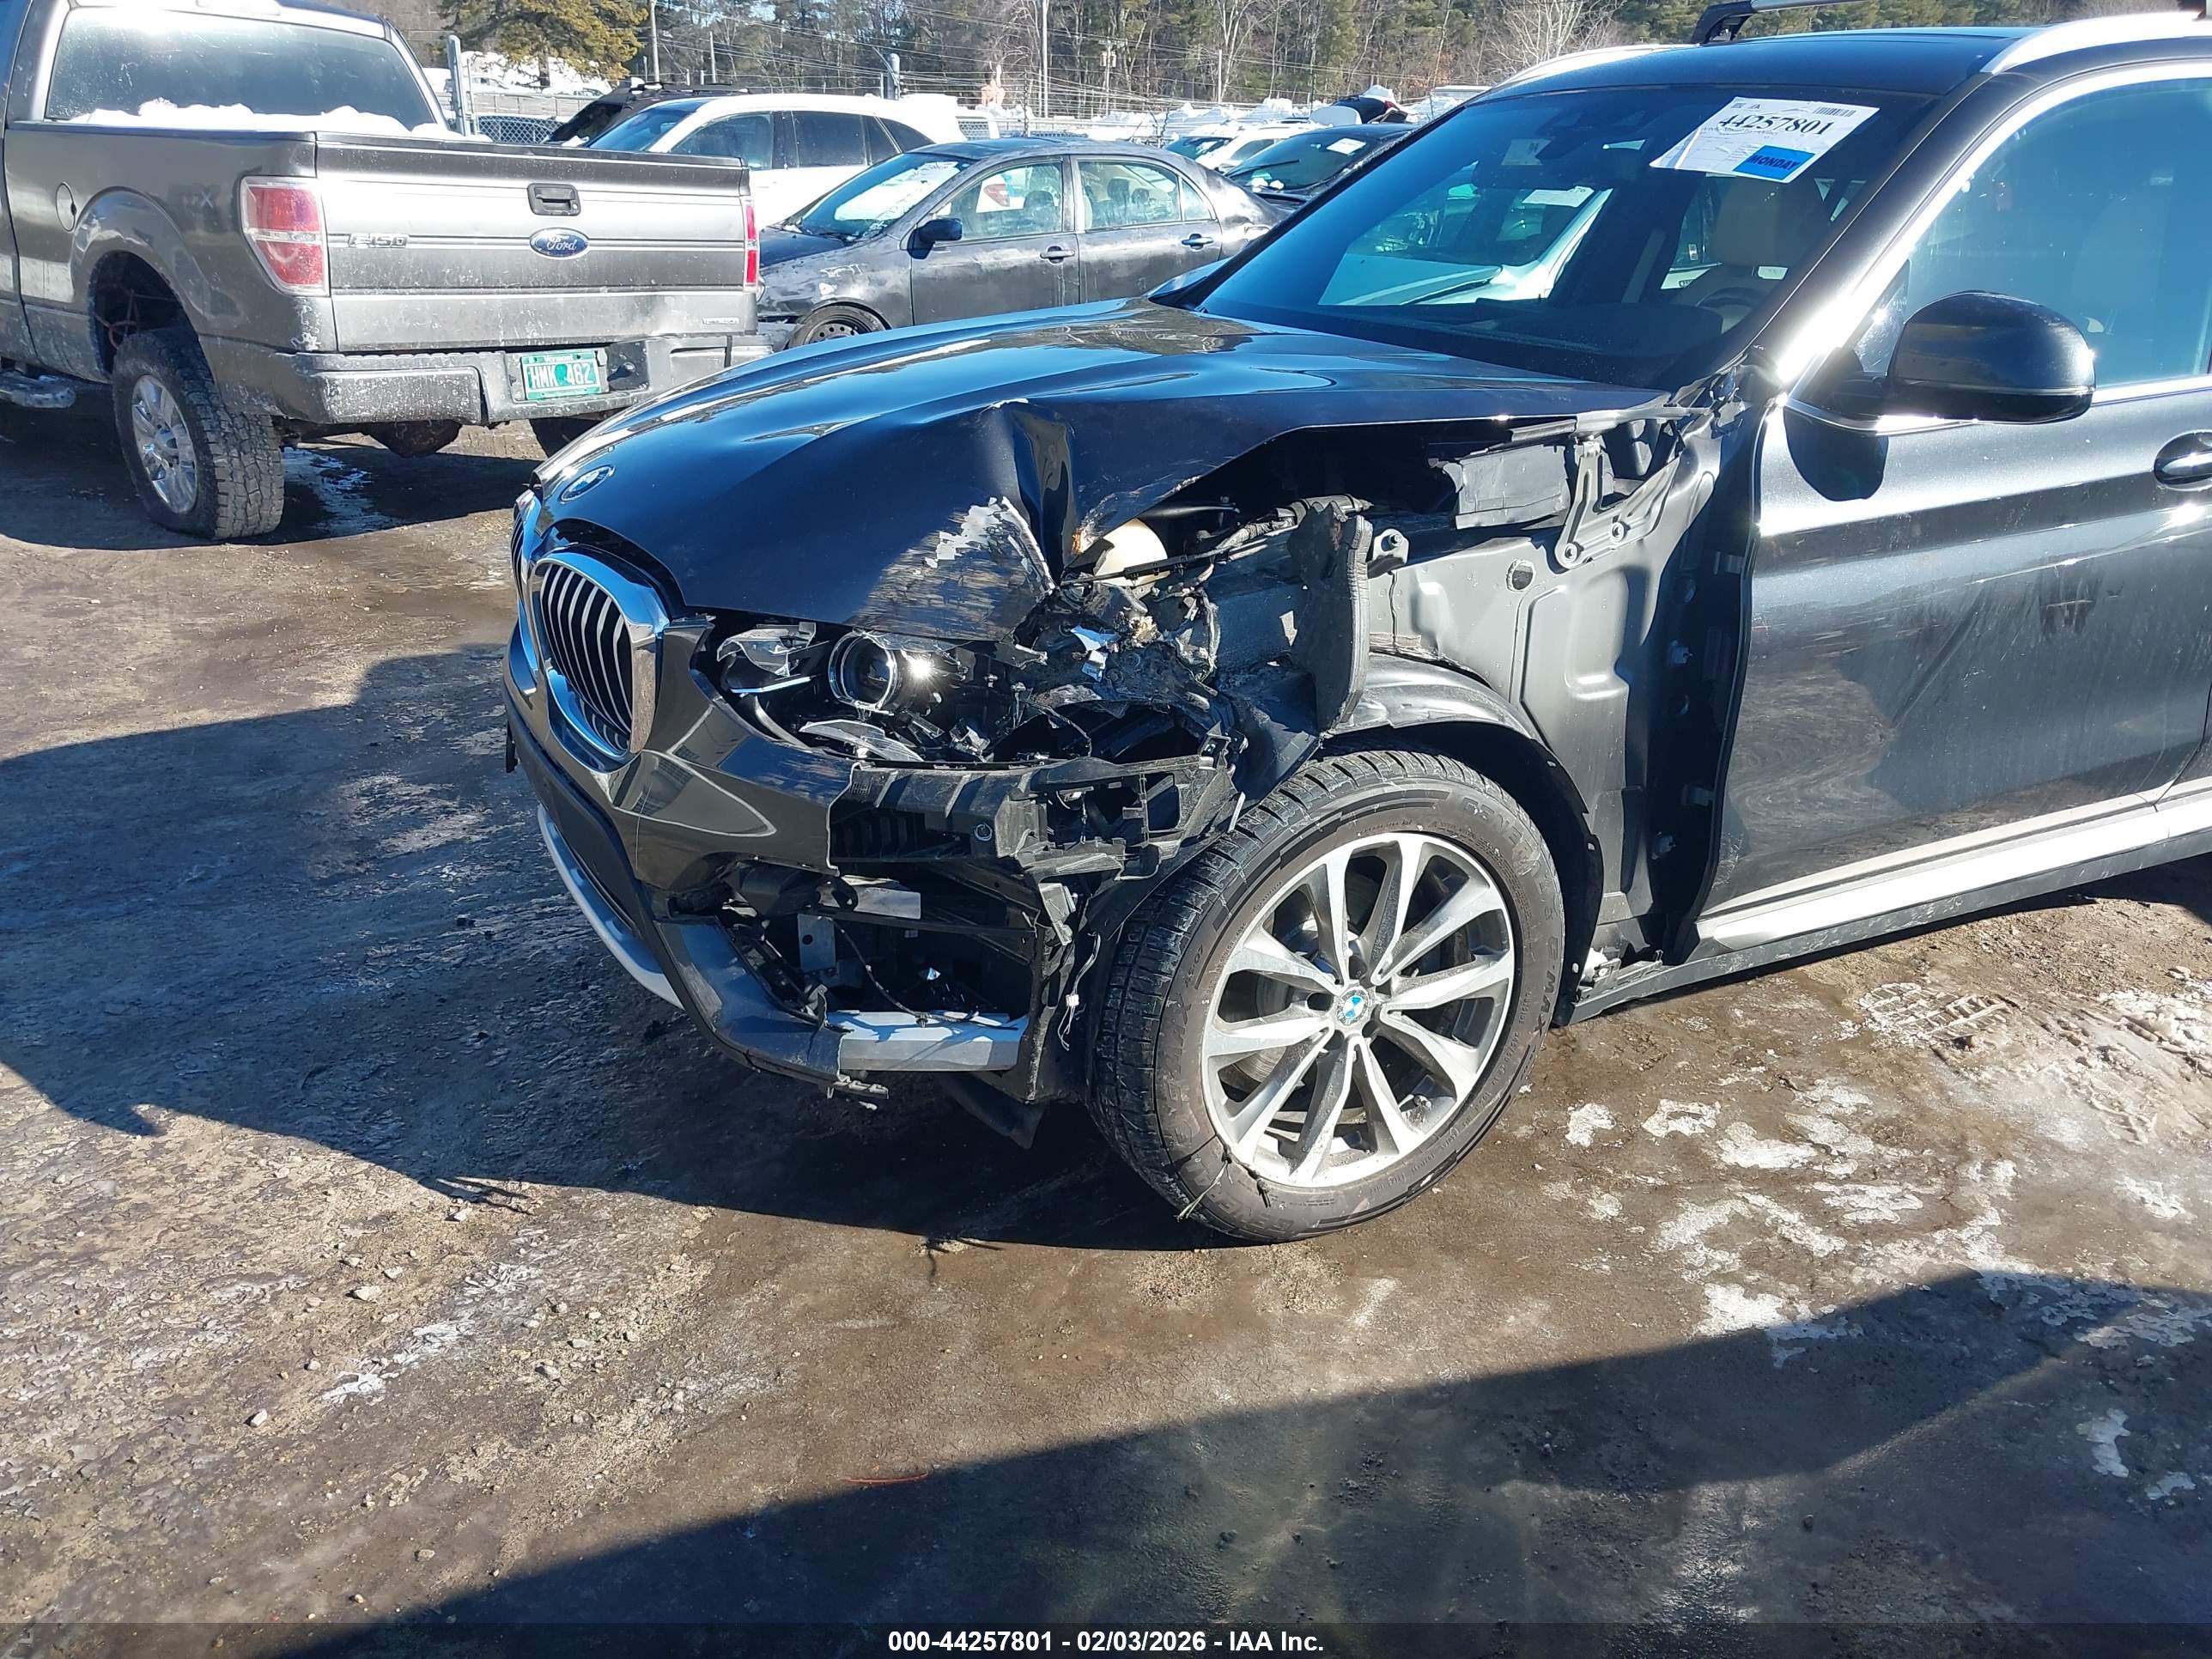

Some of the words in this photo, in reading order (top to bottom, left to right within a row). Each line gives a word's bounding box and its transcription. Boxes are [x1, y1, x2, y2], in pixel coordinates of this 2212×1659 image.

[1719, 113, 1835, 136] 44257801
[1747, 155, 1801, 171] MONDAY
[348, 234, 408, 249] F-150
[529, 365, 559, 390] HMK
[565, 362, 595, 386] 482
